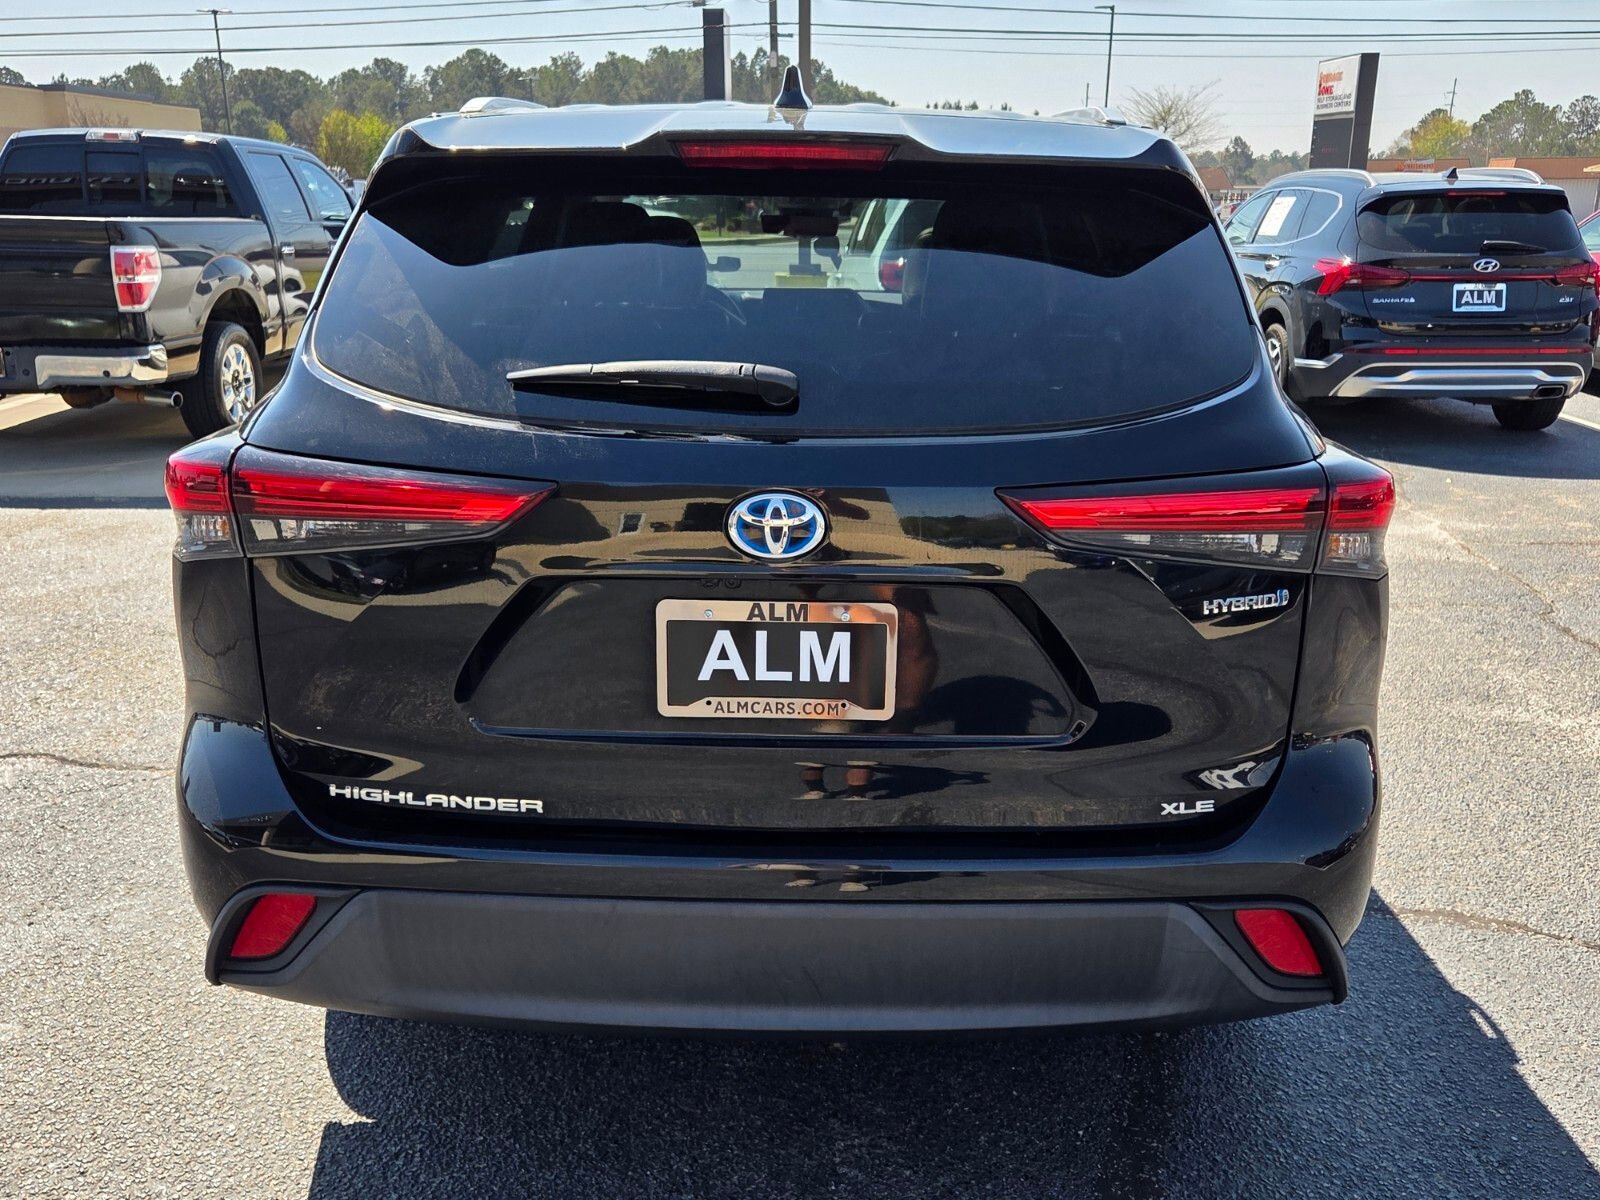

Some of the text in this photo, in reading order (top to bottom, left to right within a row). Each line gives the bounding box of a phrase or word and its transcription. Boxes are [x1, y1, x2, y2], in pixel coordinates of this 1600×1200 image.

[1461, 290, 1496, 304] ALM
[747, 602, 808, 621] ALM
[1203, 595, 1276, 615] HYBRID
[697, 629, 850, 682] ALM
[713, 701, 838, 716] ALMCARS.COM
[329, 783, 543, 813] HIGHLANDER
[1160, 800, 1215, 815] XLE
